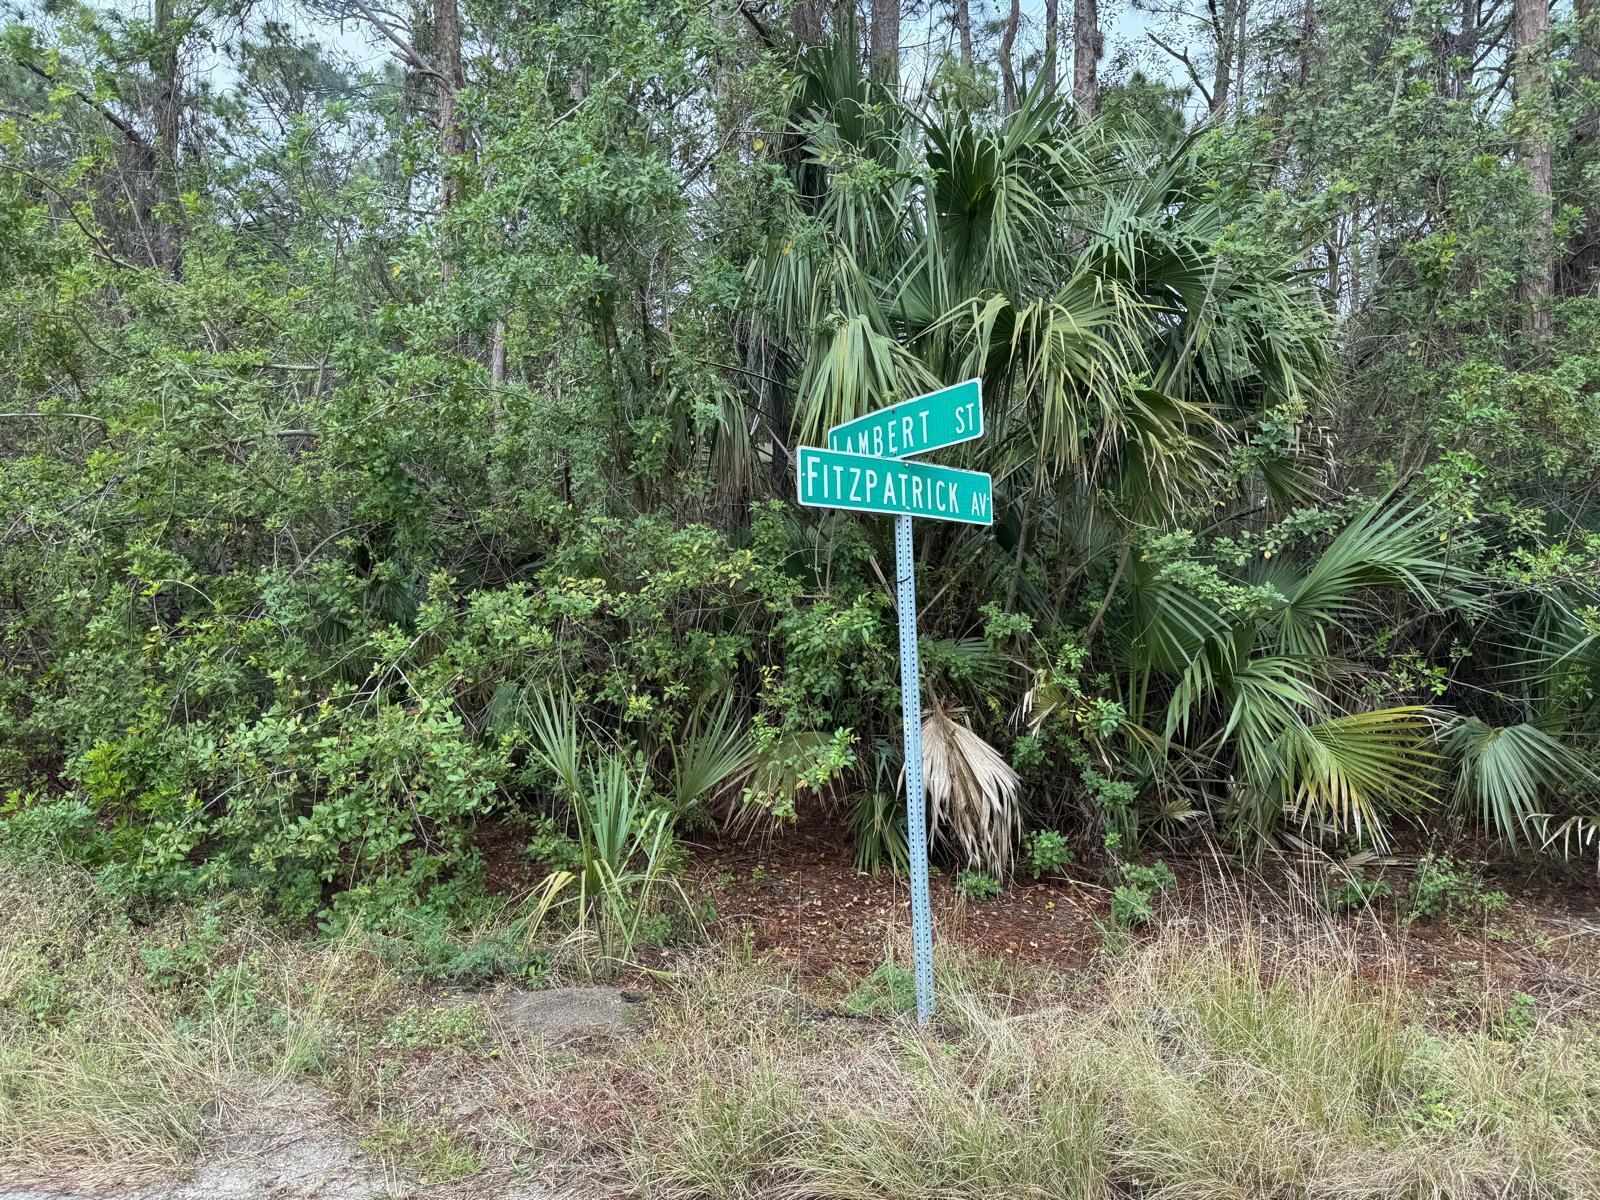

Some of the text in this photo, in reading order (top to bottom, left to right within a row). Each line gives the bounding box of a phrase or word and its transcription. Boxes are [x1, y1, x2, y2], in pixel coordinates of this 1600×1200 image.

[955, 403, 975, 434] ST
[806, 456, 987, 517] FITZPATRICK AV
